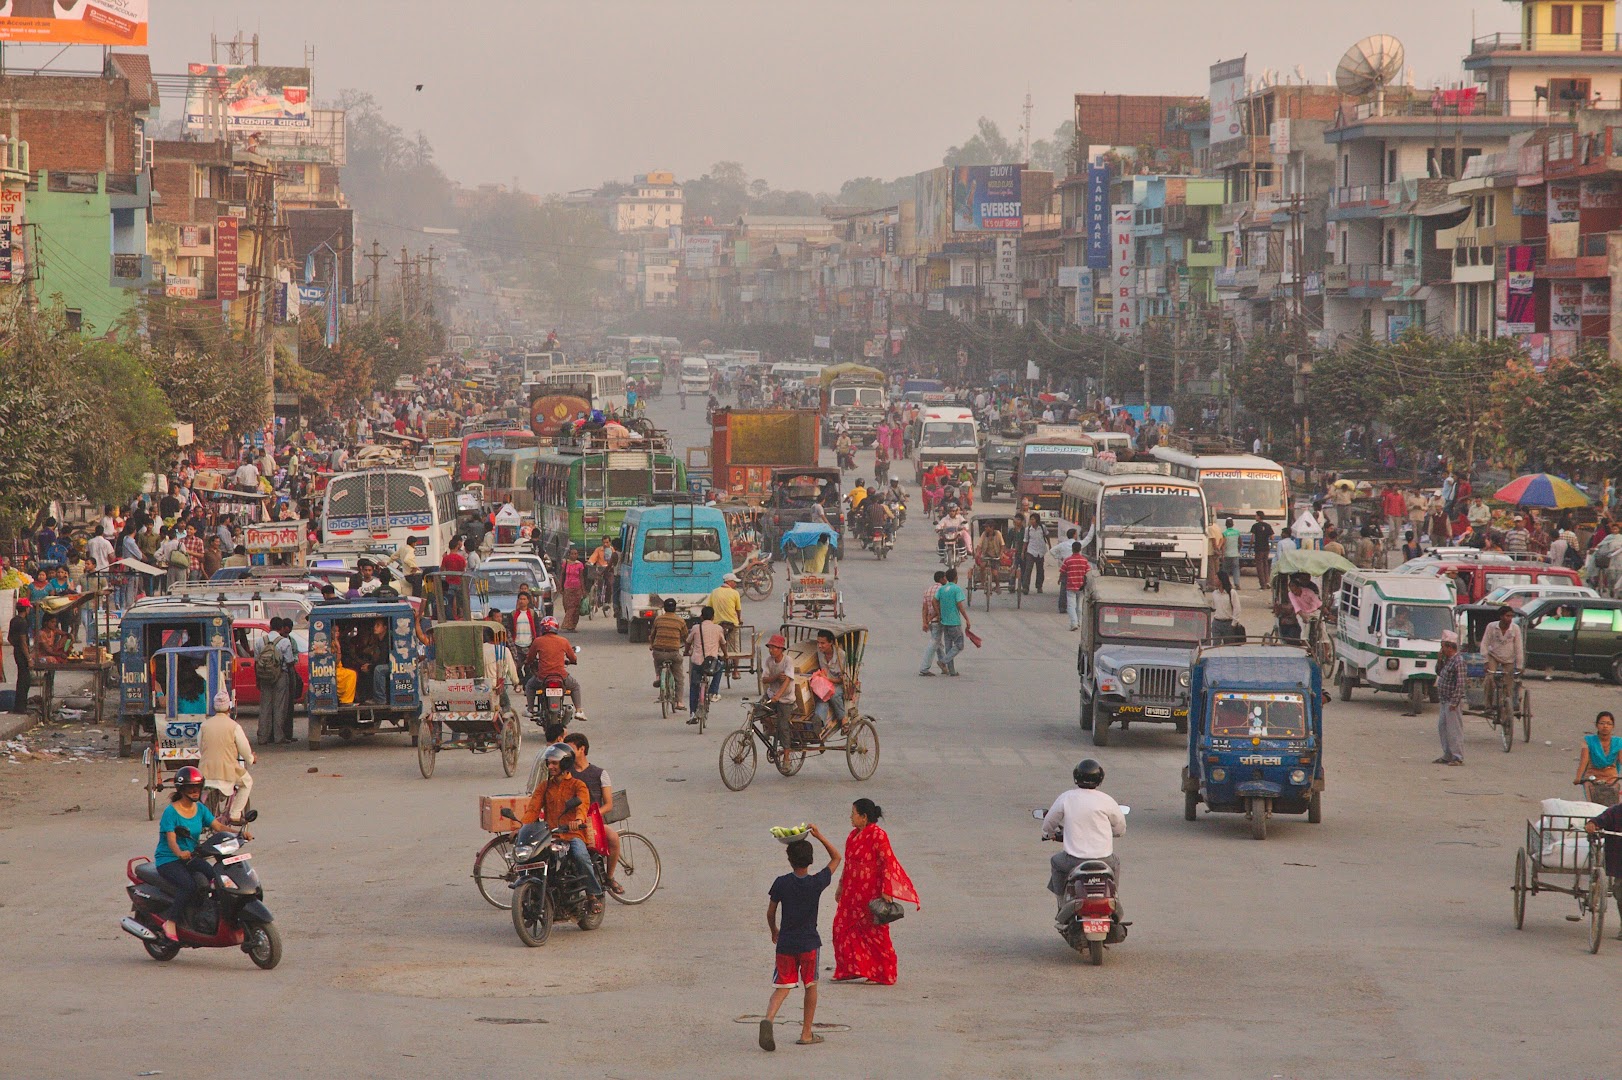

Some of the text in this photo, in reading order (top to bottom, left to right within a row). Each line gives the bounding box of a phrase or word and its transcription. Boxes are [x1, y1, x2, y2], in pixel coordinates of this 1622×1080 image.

[990, 166, 1008, 176] ENJOY
[981, 202, 1021, 217] EVEREST
[1094, 176, 1102, 249] LANDMARK
[1119, 234, 1130, 277] NIC
[121, 663, 147, 683] HORN
[311, 661, 336, 677] HORN
